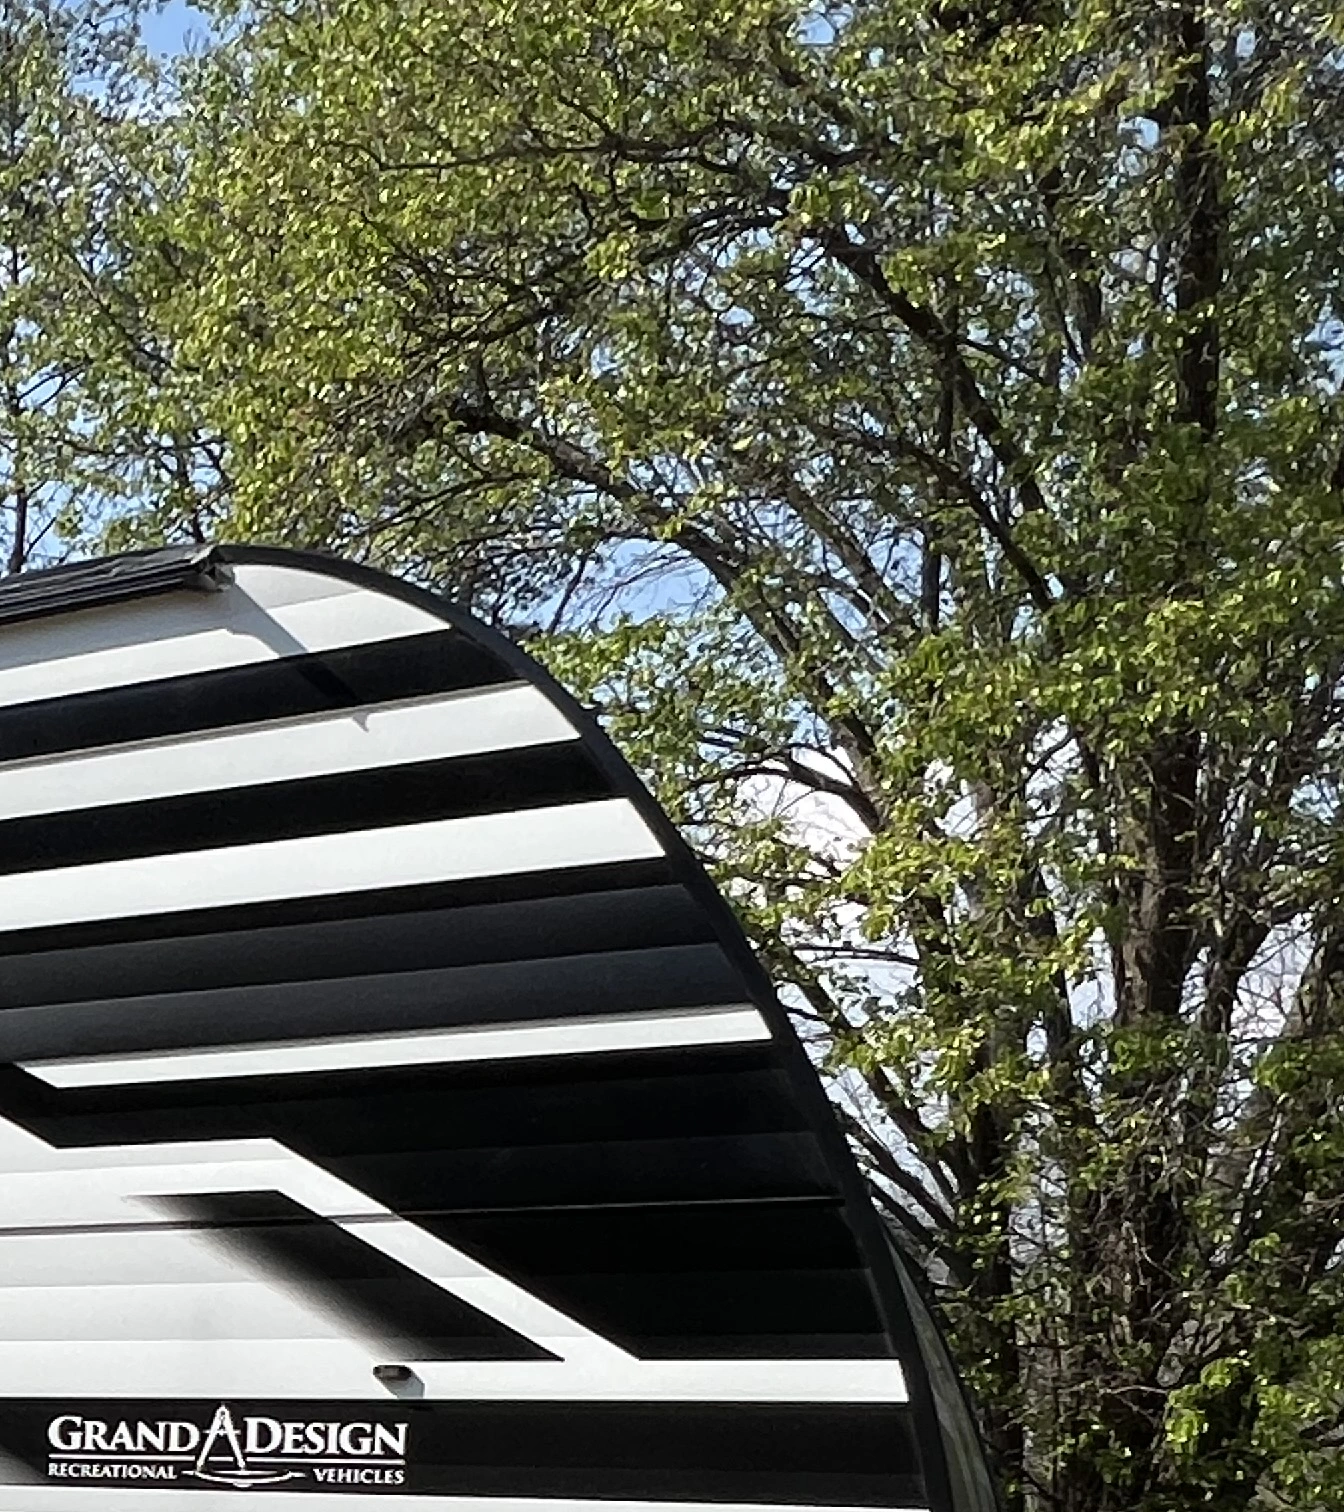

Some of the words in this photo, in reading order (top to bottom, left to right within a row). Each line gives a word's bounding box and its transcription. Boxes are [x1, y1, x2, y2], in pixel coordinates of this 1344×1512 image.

[47, 1415, 200, 1452] GRAND
[243, 1417, 408, 1455] DESIGN
[48, 1462, 178, 1480] RECREATIONAL
[313, 1468, 405, 1485] VEHICLES
